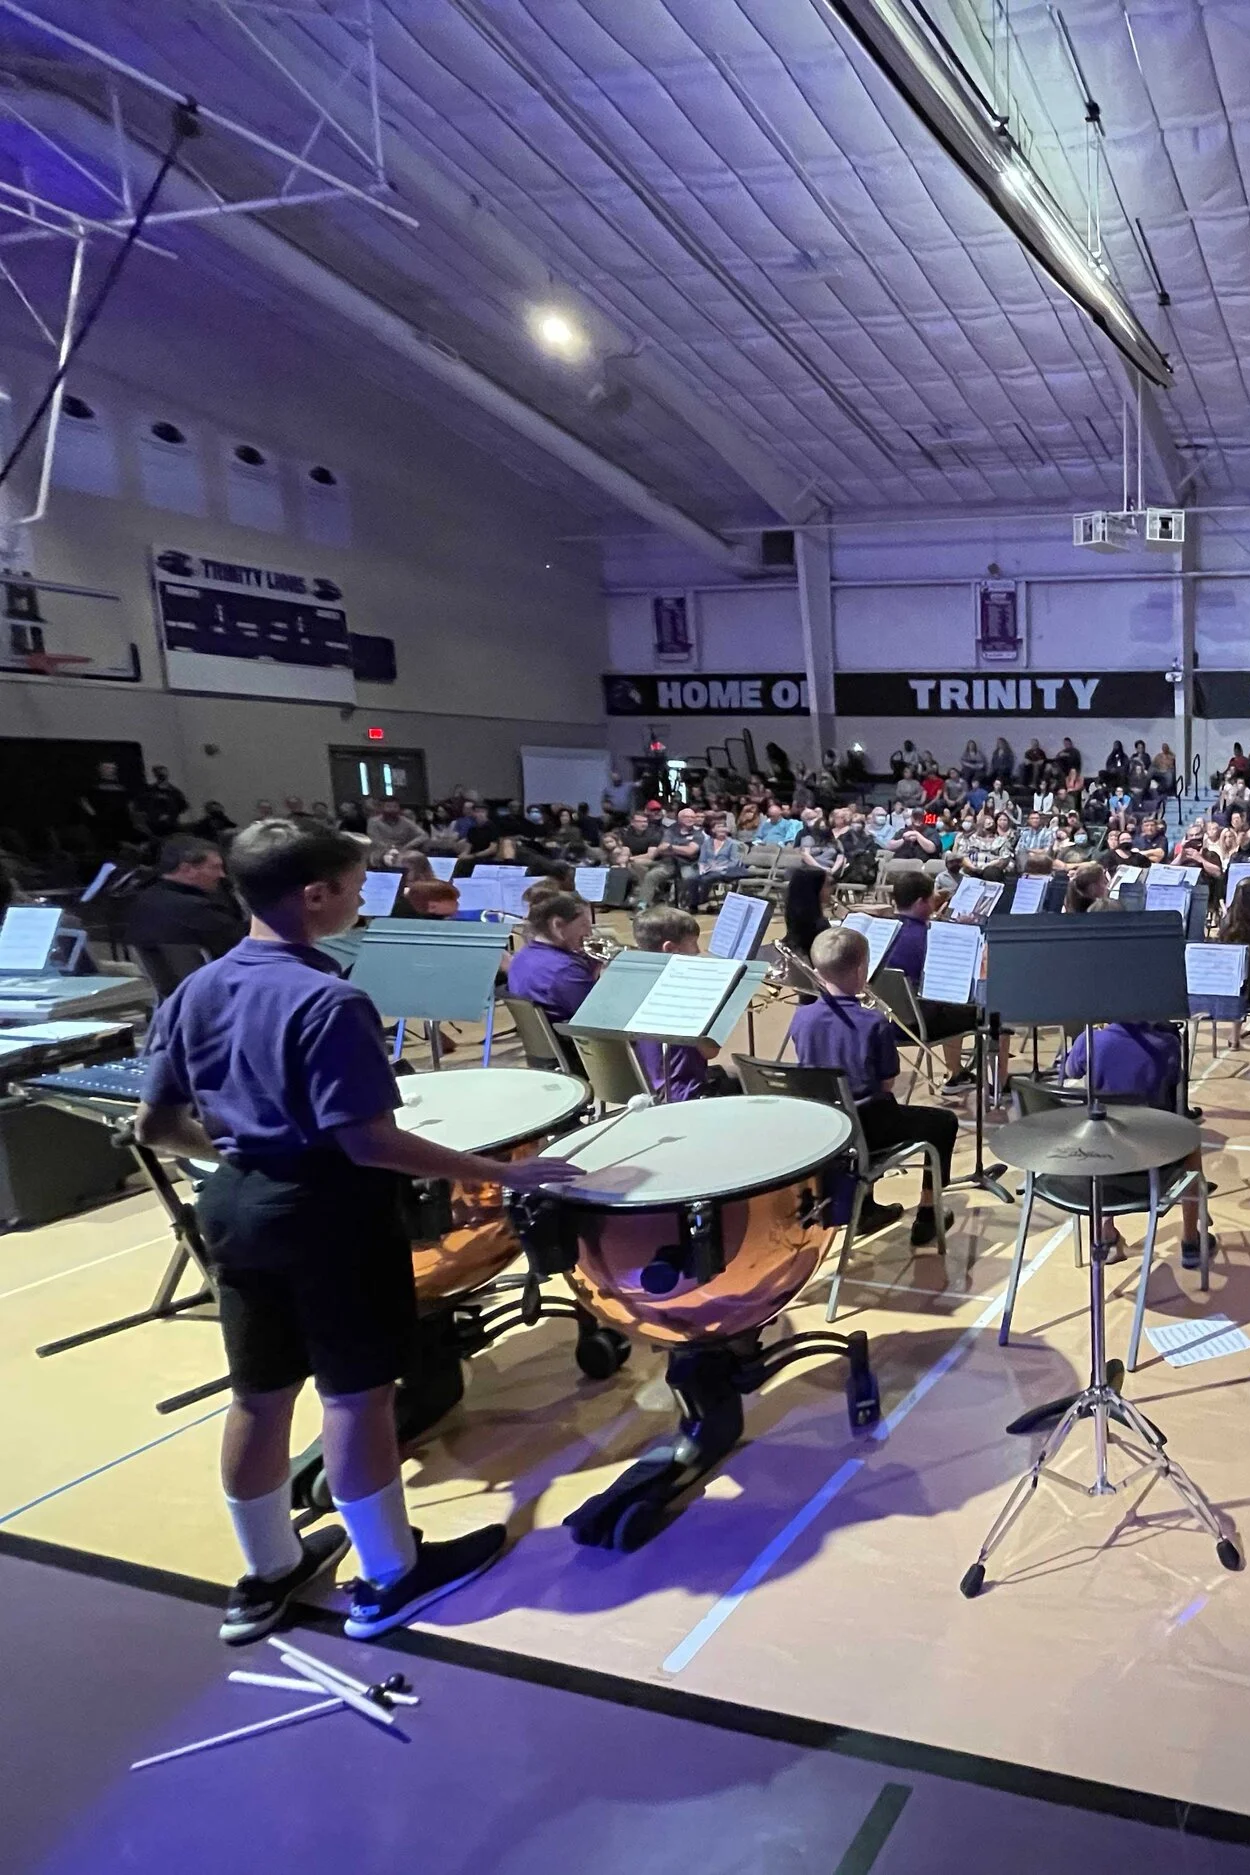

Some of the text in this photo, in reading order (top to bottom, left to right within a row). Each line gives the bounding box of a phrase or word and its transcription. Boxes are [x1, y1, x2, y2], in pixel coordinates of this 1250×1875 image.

[199, 558, 262, 587] TRINITY
[657, 680, 763, 709] HOME
[908, 679, 1100, 710] TRINITY
